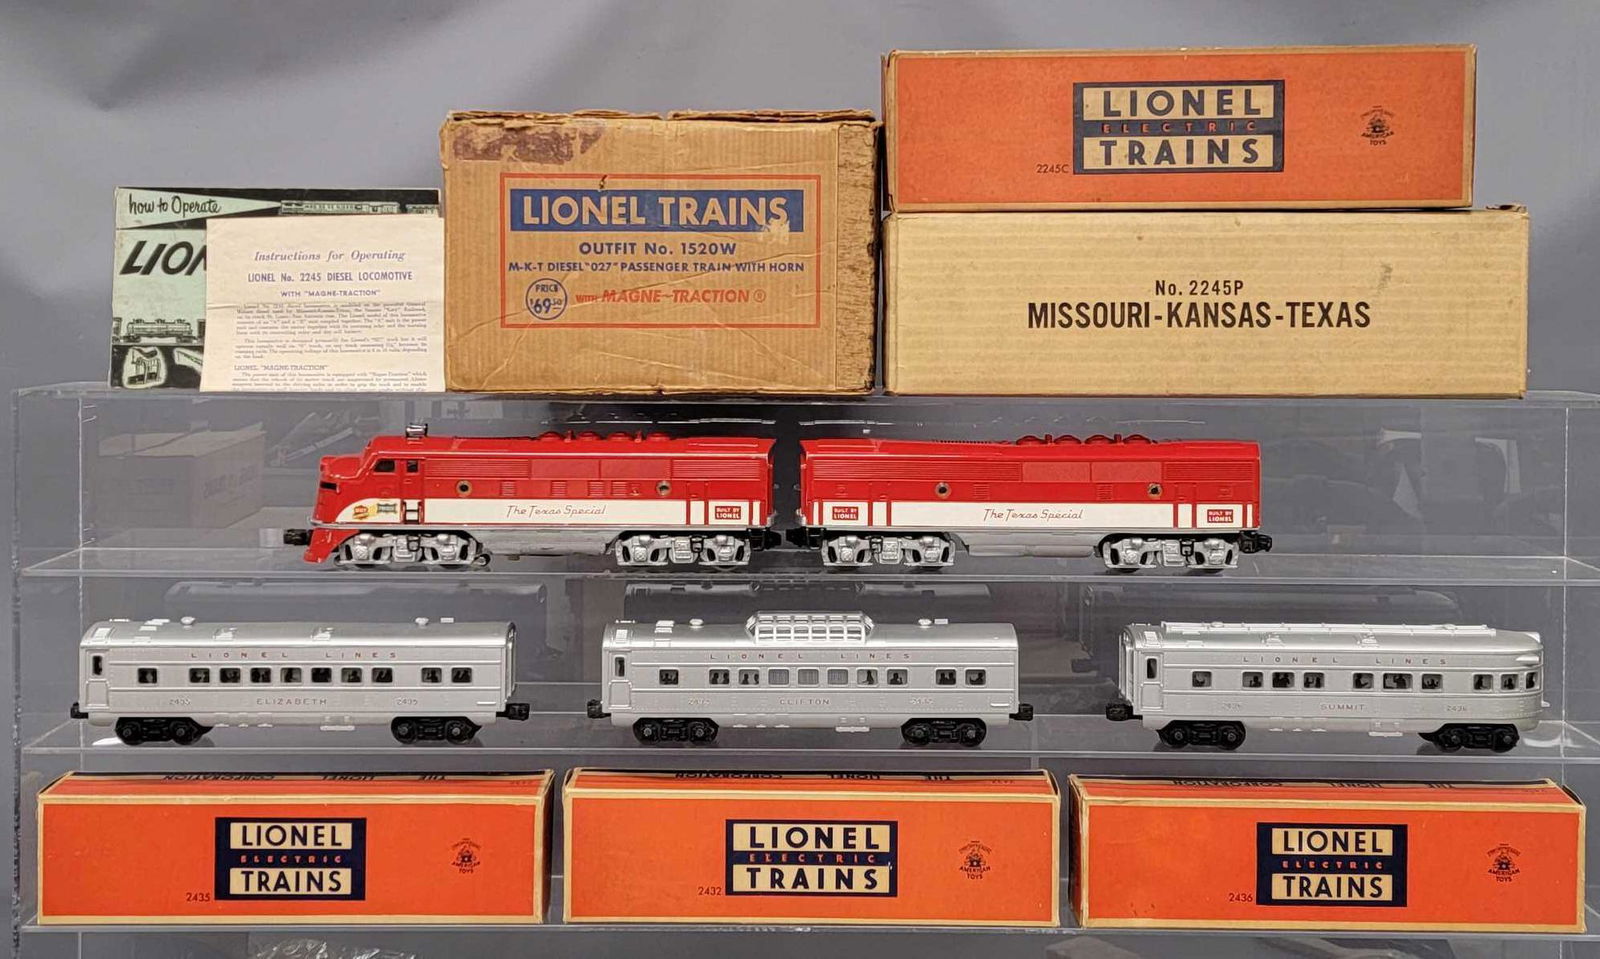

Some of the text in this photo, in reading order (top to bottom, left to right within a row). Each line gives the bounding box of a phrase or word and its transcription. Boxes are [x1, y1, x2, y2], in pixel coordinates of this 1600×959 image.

[1103, 88, 1262, 118] LIONEL
[1101, 120, 1257, 135] ELECTRIC
[1099, 138, 1260, 166] TRAINS
[1036, 164, 1069, 174] 2245C
[128, 193, 222, 218] how to Operate
[522, 195, 789, 226] LIONEL TRAINS
[254, 249, 406, 263] Instructions for Operating
[578, 242, 737, 256] OUTFIT No. 1520W
[508, 262, 543, 272] M-K-T
[547, 262, 584, 272] DIESEL
[620, 262, 689, 272] PASSENGER
[693, 262, 732, 272] TRAIN
[735, 262, 768, 272] WITH
[769, 262, 805, 273] HORN
[248, 271, 413, 283] LIONEL No. 2245 DIESEL LOCOMOTIVE
[280, 290, 302, 298] WITH
[1154, 280, 1244, 297] No. 2245P
[1027, 301, 1371, 330] MISSOURI-KANSAS-TEXAS
[506, 504, 607, 518] The Texas Special
[984, 508, 1084, 521] The Texas Special
[1243, 656, 1448, 665] LIONEL LINES
[256, 698, 327, 706] ELIZABETH
[1320, 703, 1366, 711] SUMMIT
[241, 825, 343, 848] LIONEL
[749, 825, 880, 850] LIONEL
[1282, 829, 1385, 854] LIONEL
[240, 856, 342, 864] ELECTRIC
[749, 853, 876, 863] ELECTRIC
[1282, 860, 1384, 870] ELECTRIC
[241, 871, 343, 894] TRAINS
[746, 867, 879, 891] TRAINS
[697, 886, 722, 897] 2432
[1283, 875, 1384, 899] TRAINS
[186, 892, 212, 903] 2435
[1228, 892, 1253, 904] 2436
